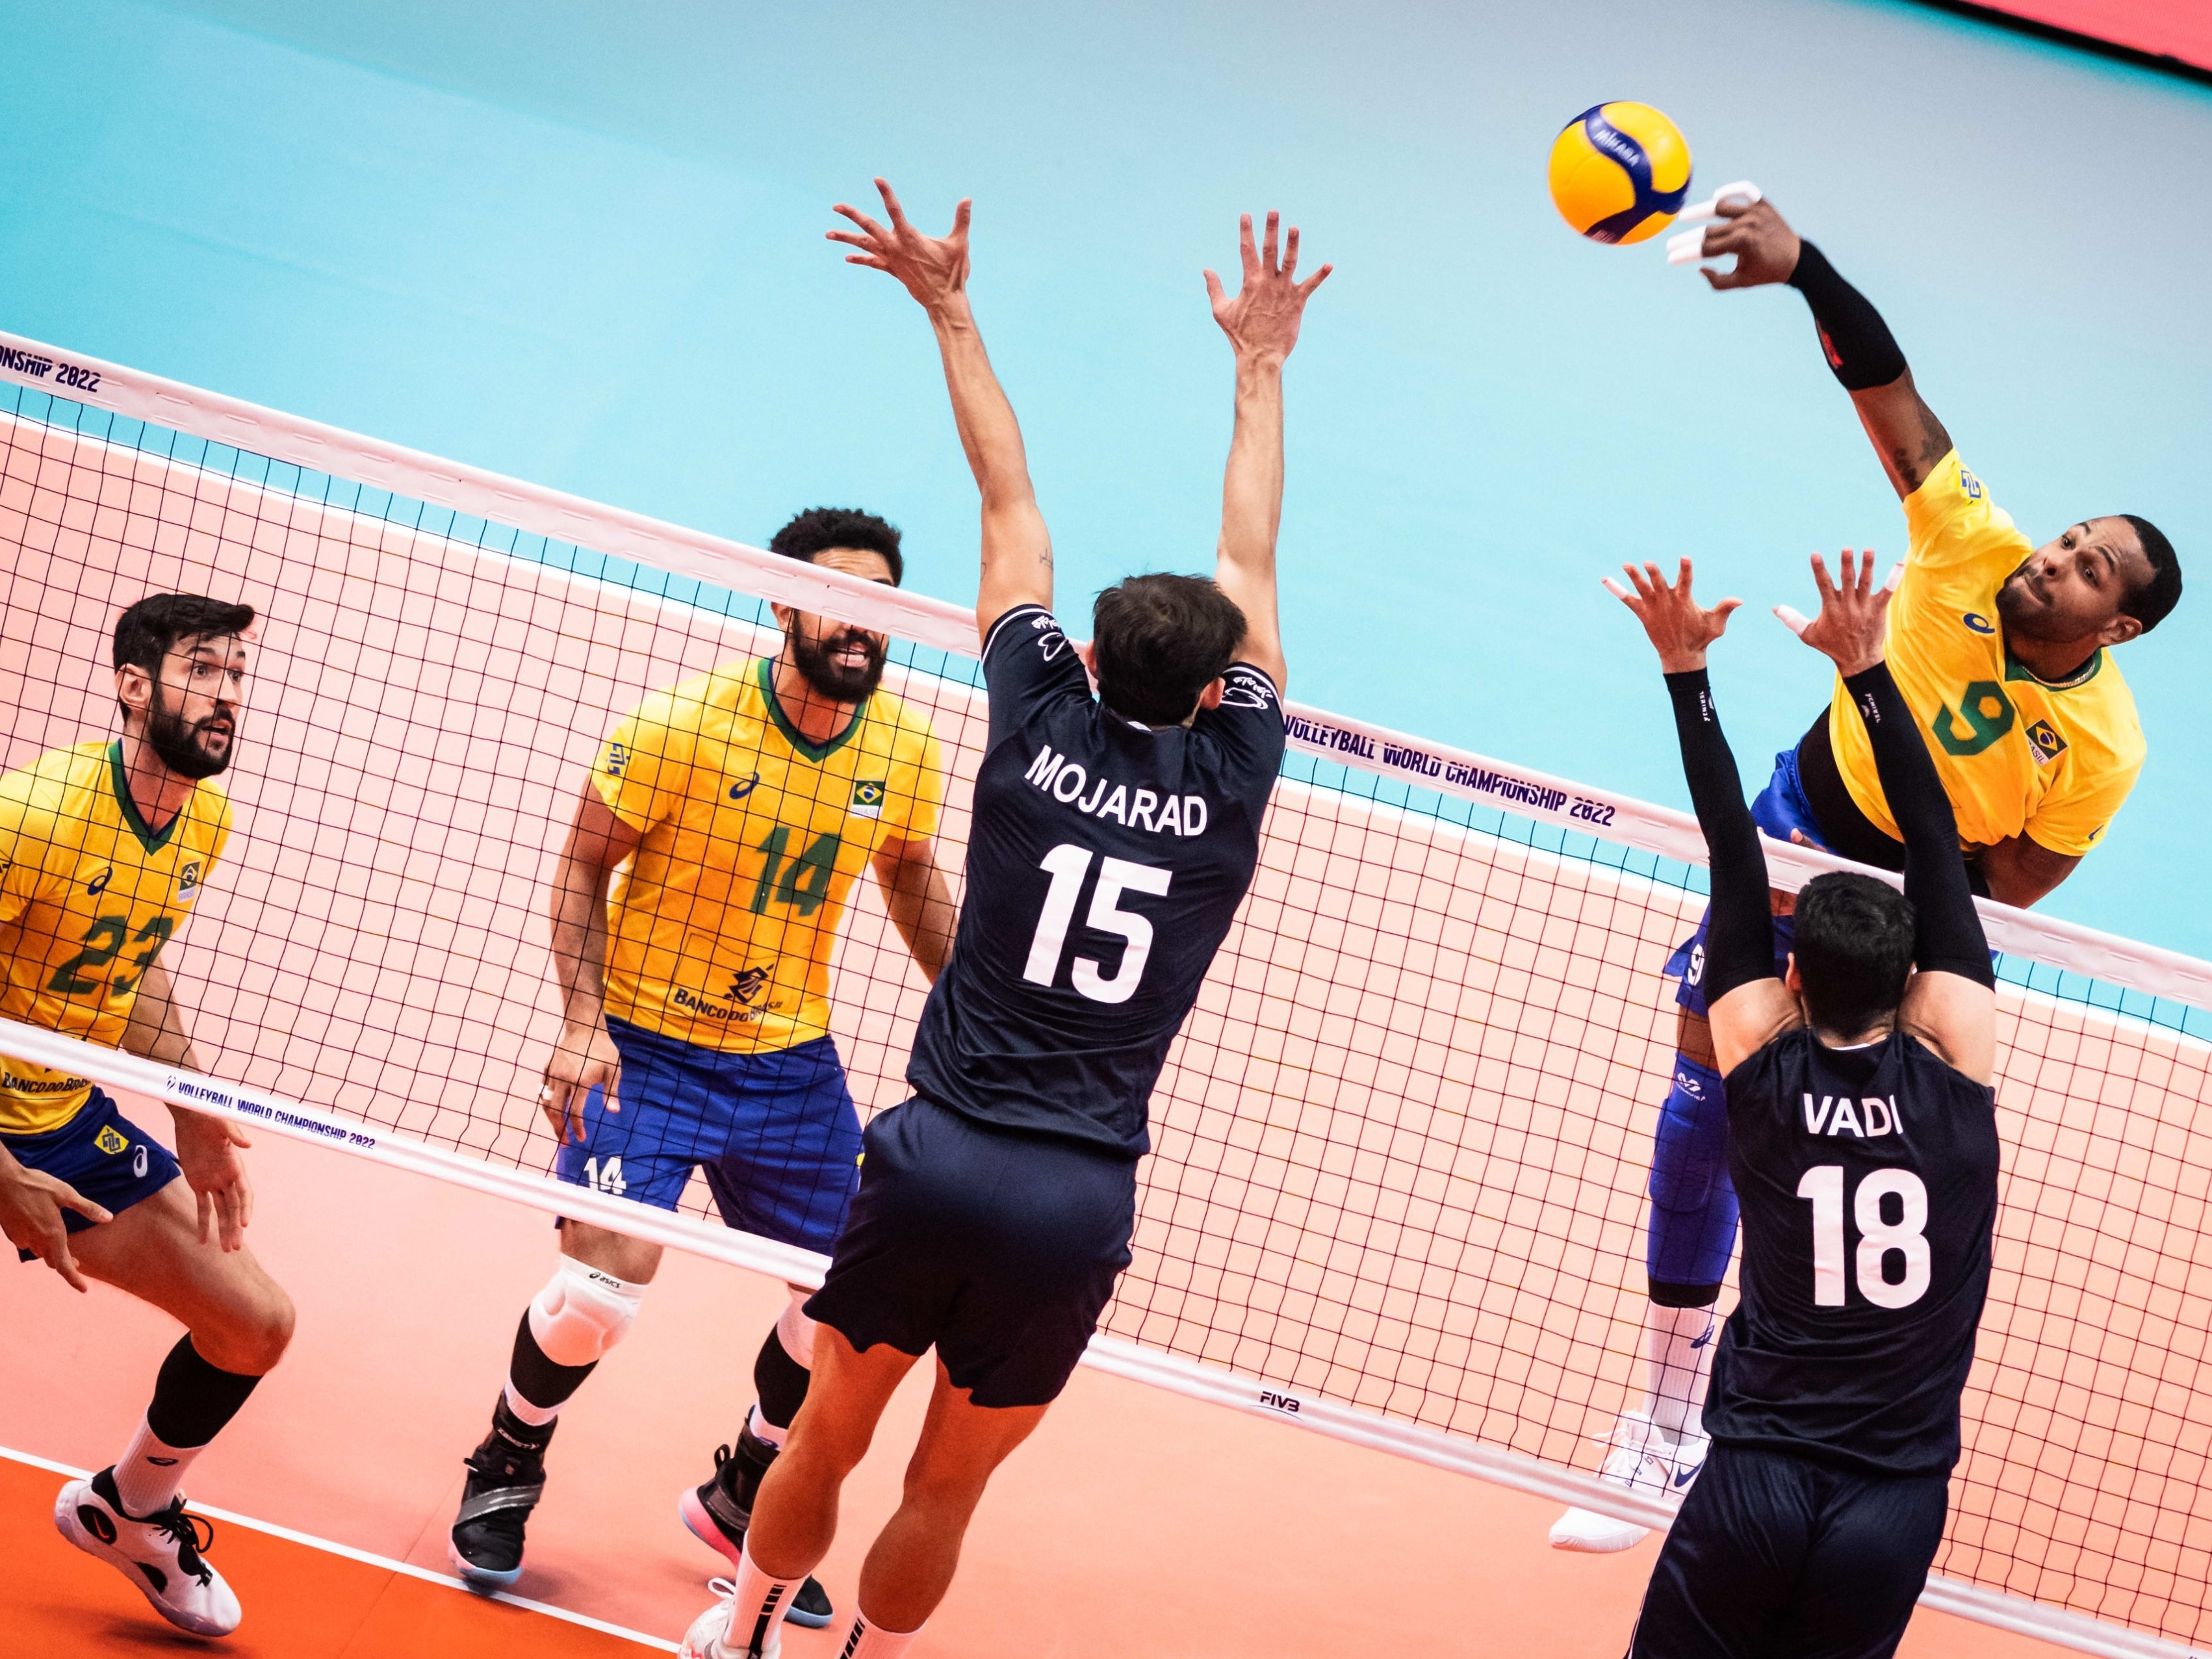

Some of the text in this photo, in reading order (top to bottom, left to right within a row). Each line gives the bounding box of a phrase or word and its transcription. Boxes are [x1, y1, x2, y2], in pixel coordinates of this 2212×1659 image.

[55, 363, 101, 392] 2022
[1931, 680, 2016, 756] 9
[1024, 744, 1207, 836] MOJARAD
[1284, 714, 1615, 827] VOLLEYBALL WORLD CHAMPIONSHIP 2022
[749, 826, 842, 917] 14
[46, 915, 174, 997] 23
[1023, 843, 1173, 1004] 15
[1687, 943, 1705, 986] 9
[673, 987, 728, 1020] BANCO
[728, 1010, 749, 1022] DO
[2, 1072, 47, 1093] BANCO
[44, 1081, 64, 1092] DO
[178, 1081, 376, 1150] VOLLEYBALL WORLD CHAMPIONSHIP 2022
[1803, 1093, 1904, 1138] VADI
[584, 1155, 626, 1194] 14
[1797, 1165, 1931, 1309] 18
